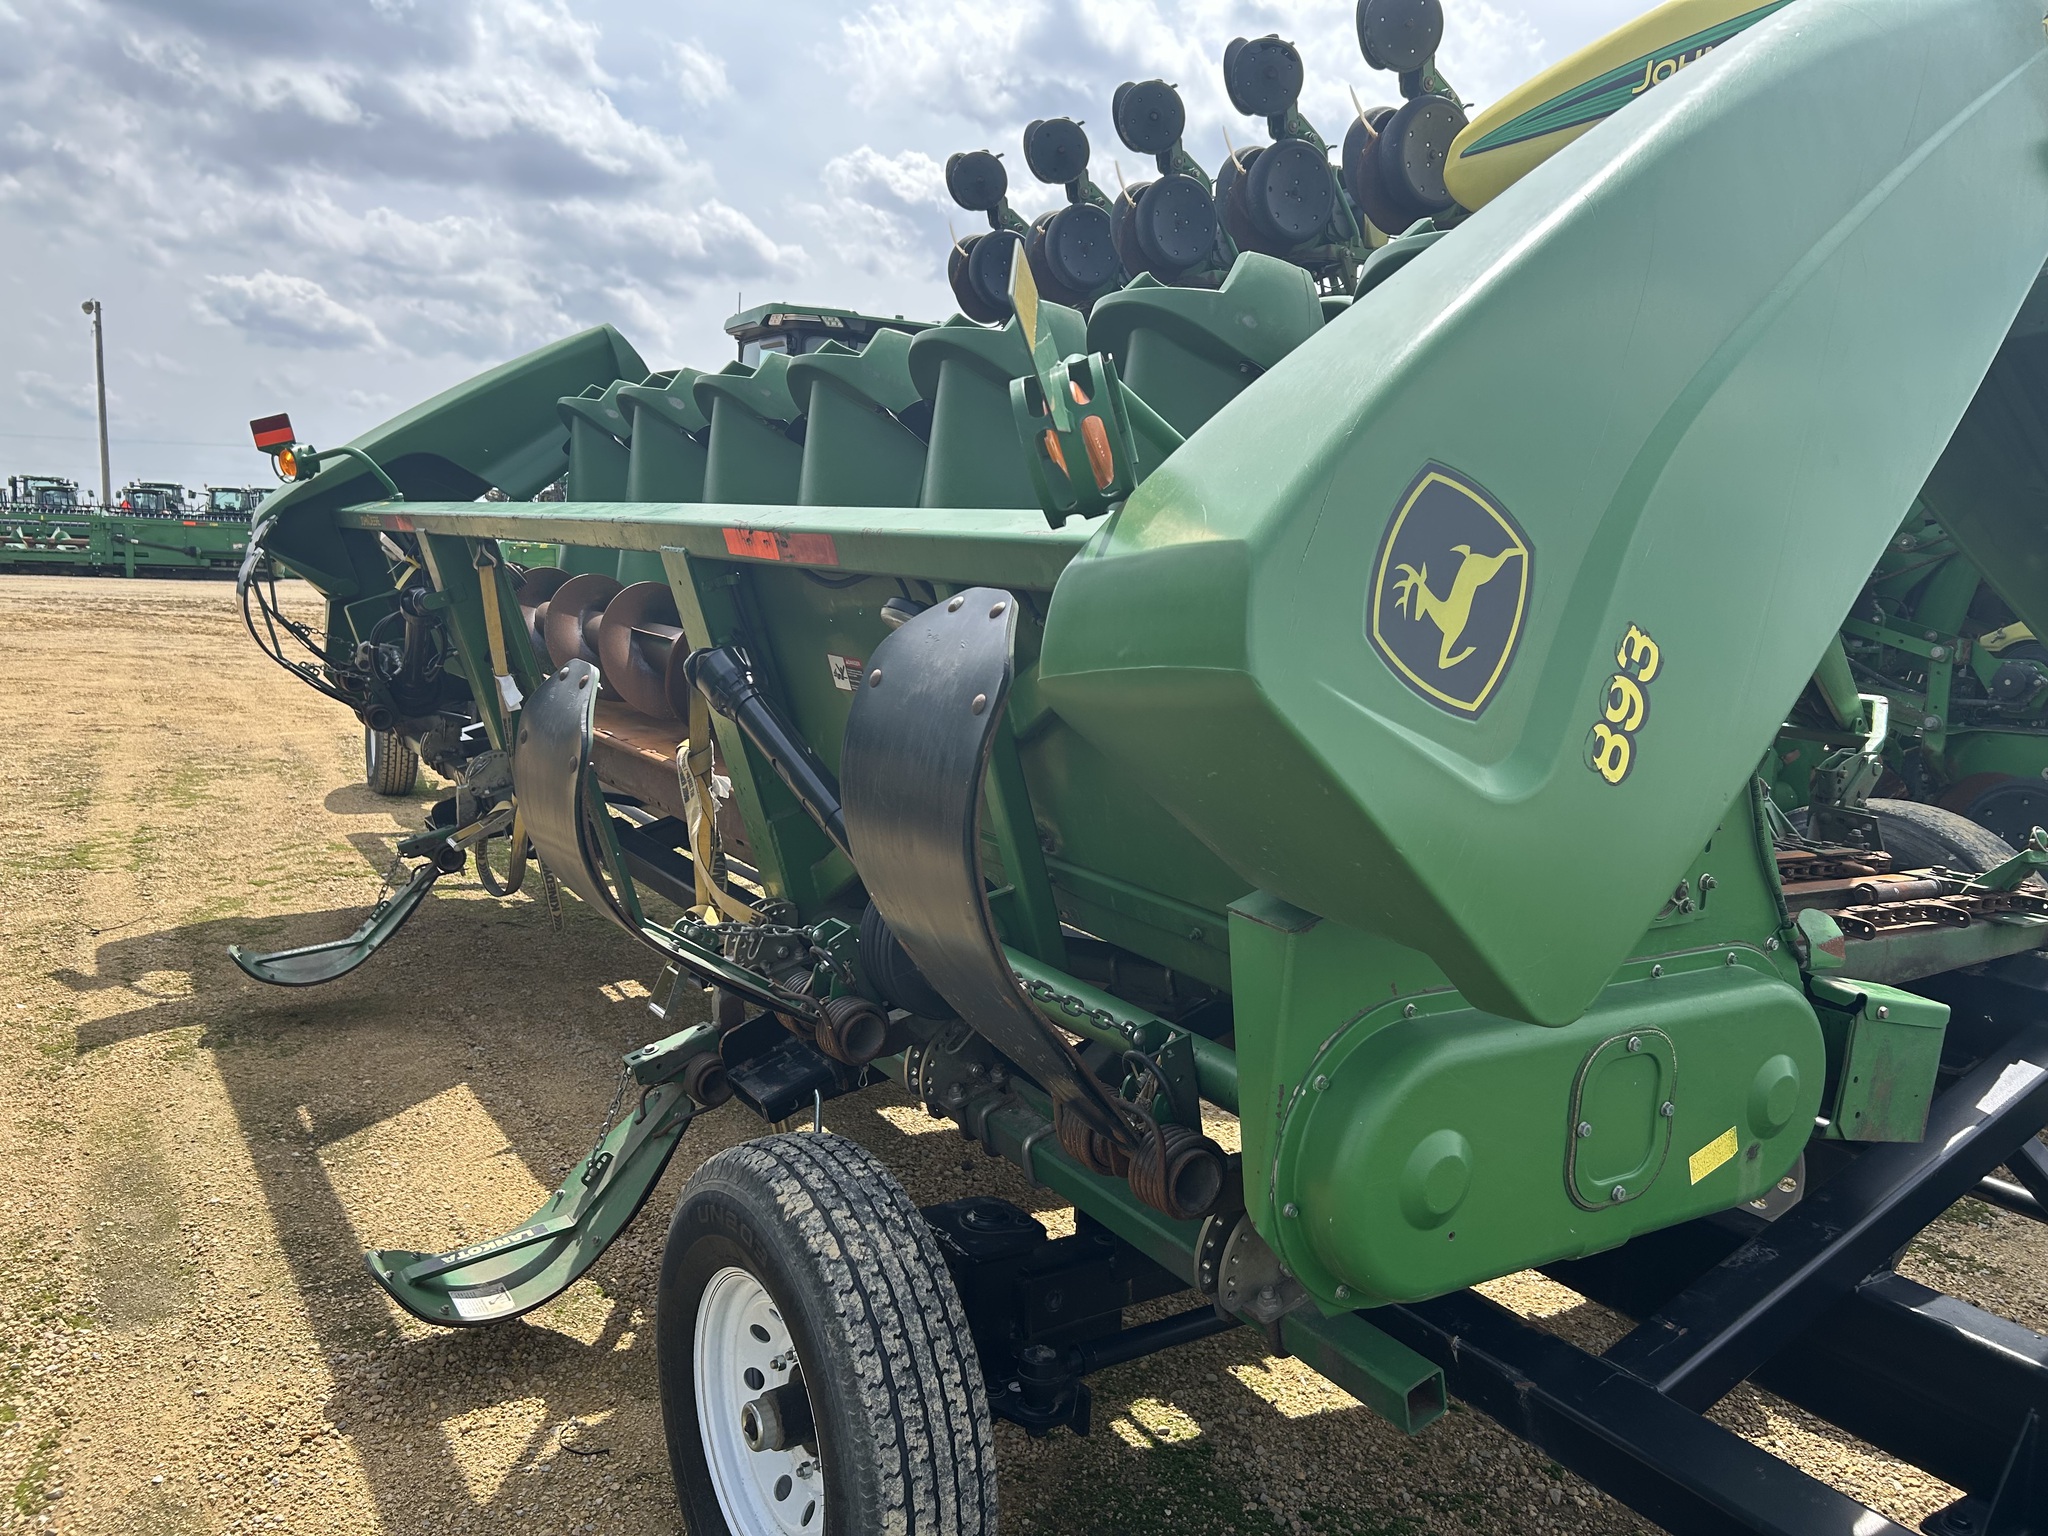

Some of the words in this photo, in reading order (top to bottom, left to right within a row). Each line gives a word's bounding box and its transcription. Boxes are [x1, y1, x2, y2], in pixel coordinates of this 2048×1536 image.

[1631, 46, 1714, 94] JOH
[1588, 622, 1662, 785] 893
[440, 1228, 535, 1265] LANKOTA
